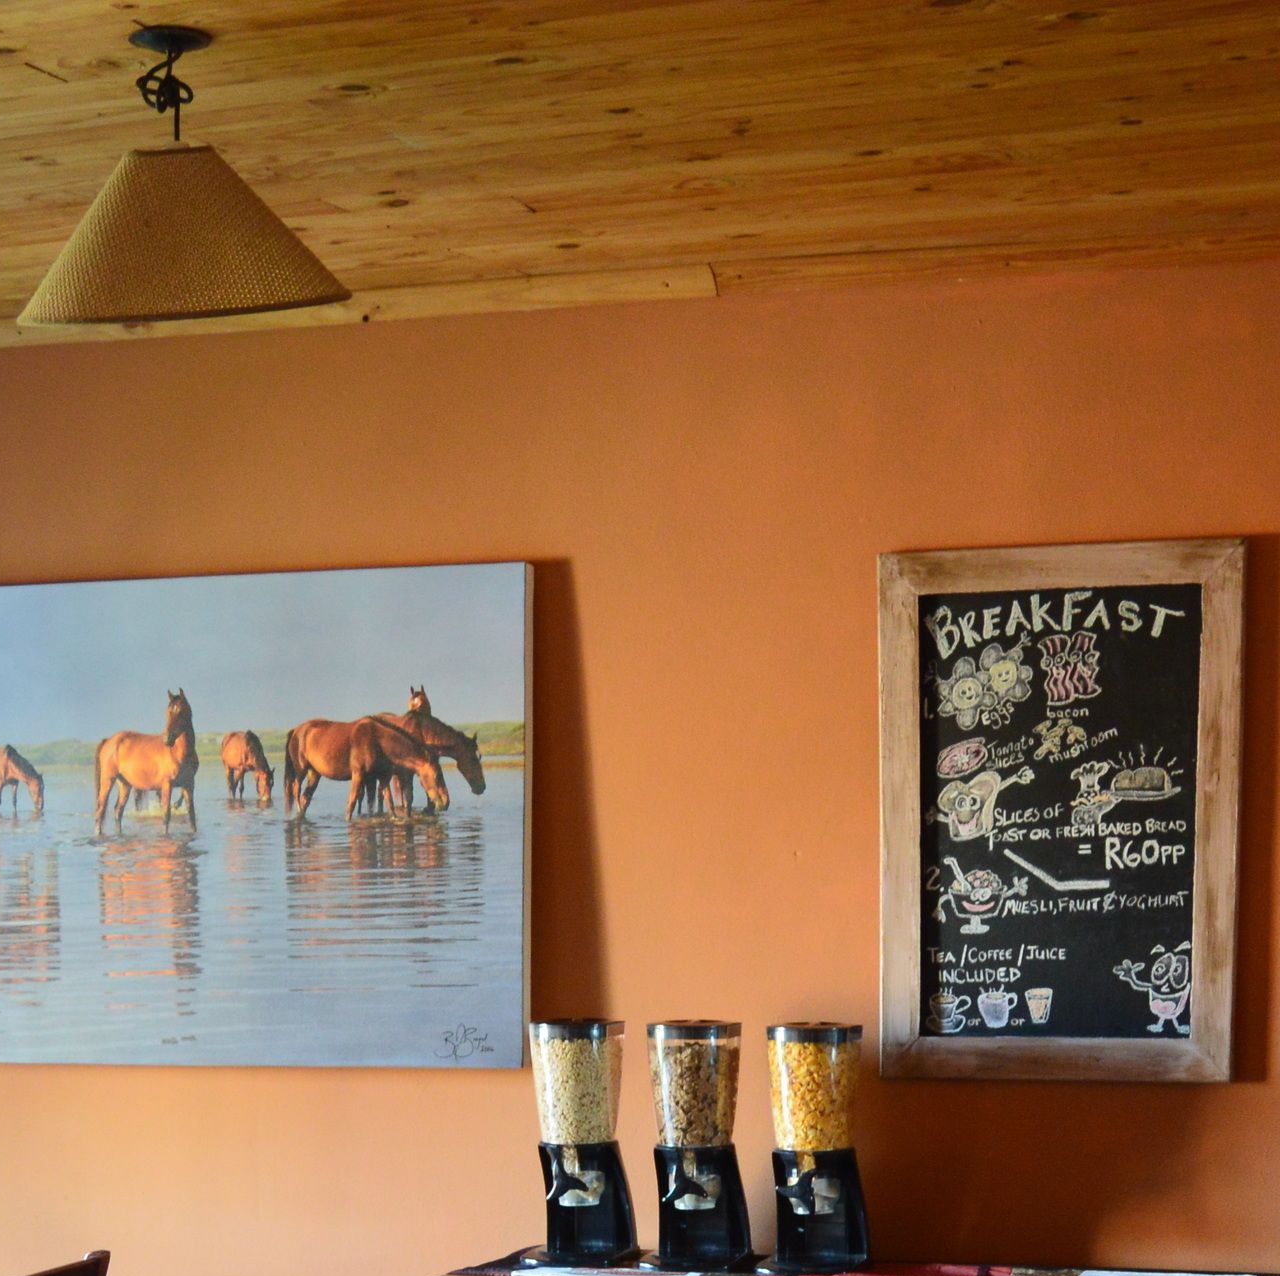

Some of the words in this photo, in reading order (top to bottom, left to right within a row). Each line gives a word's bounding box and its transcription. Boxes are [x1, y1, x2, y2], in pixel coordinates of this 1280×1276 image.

[926, 590, 1186, 660] BREAKFAST
[1046, 707, 1089, 719] bacon
[986, 736, 1035, 761] Tomato
[994, 806, 1041, 827] SLICES
[1043, 802, 1065, 820] OF
[984, 827, 1027, 852] TOAST
[1029, 827, 1052, 840] OR
[1056, 823, 1096, 838] FRESH
[1098, 822, 1142, 837] BAKED
[1144, 818, 1187, 834] BREAD
[1118, 891, 1189, 909] YOGHURT
[927, 947, 956, 963] TEA
[938, 967, 1021, 984] INCLUDED
[967, 1016, 982, 1026] or
[1010, 1016, 1026, 1026] or
